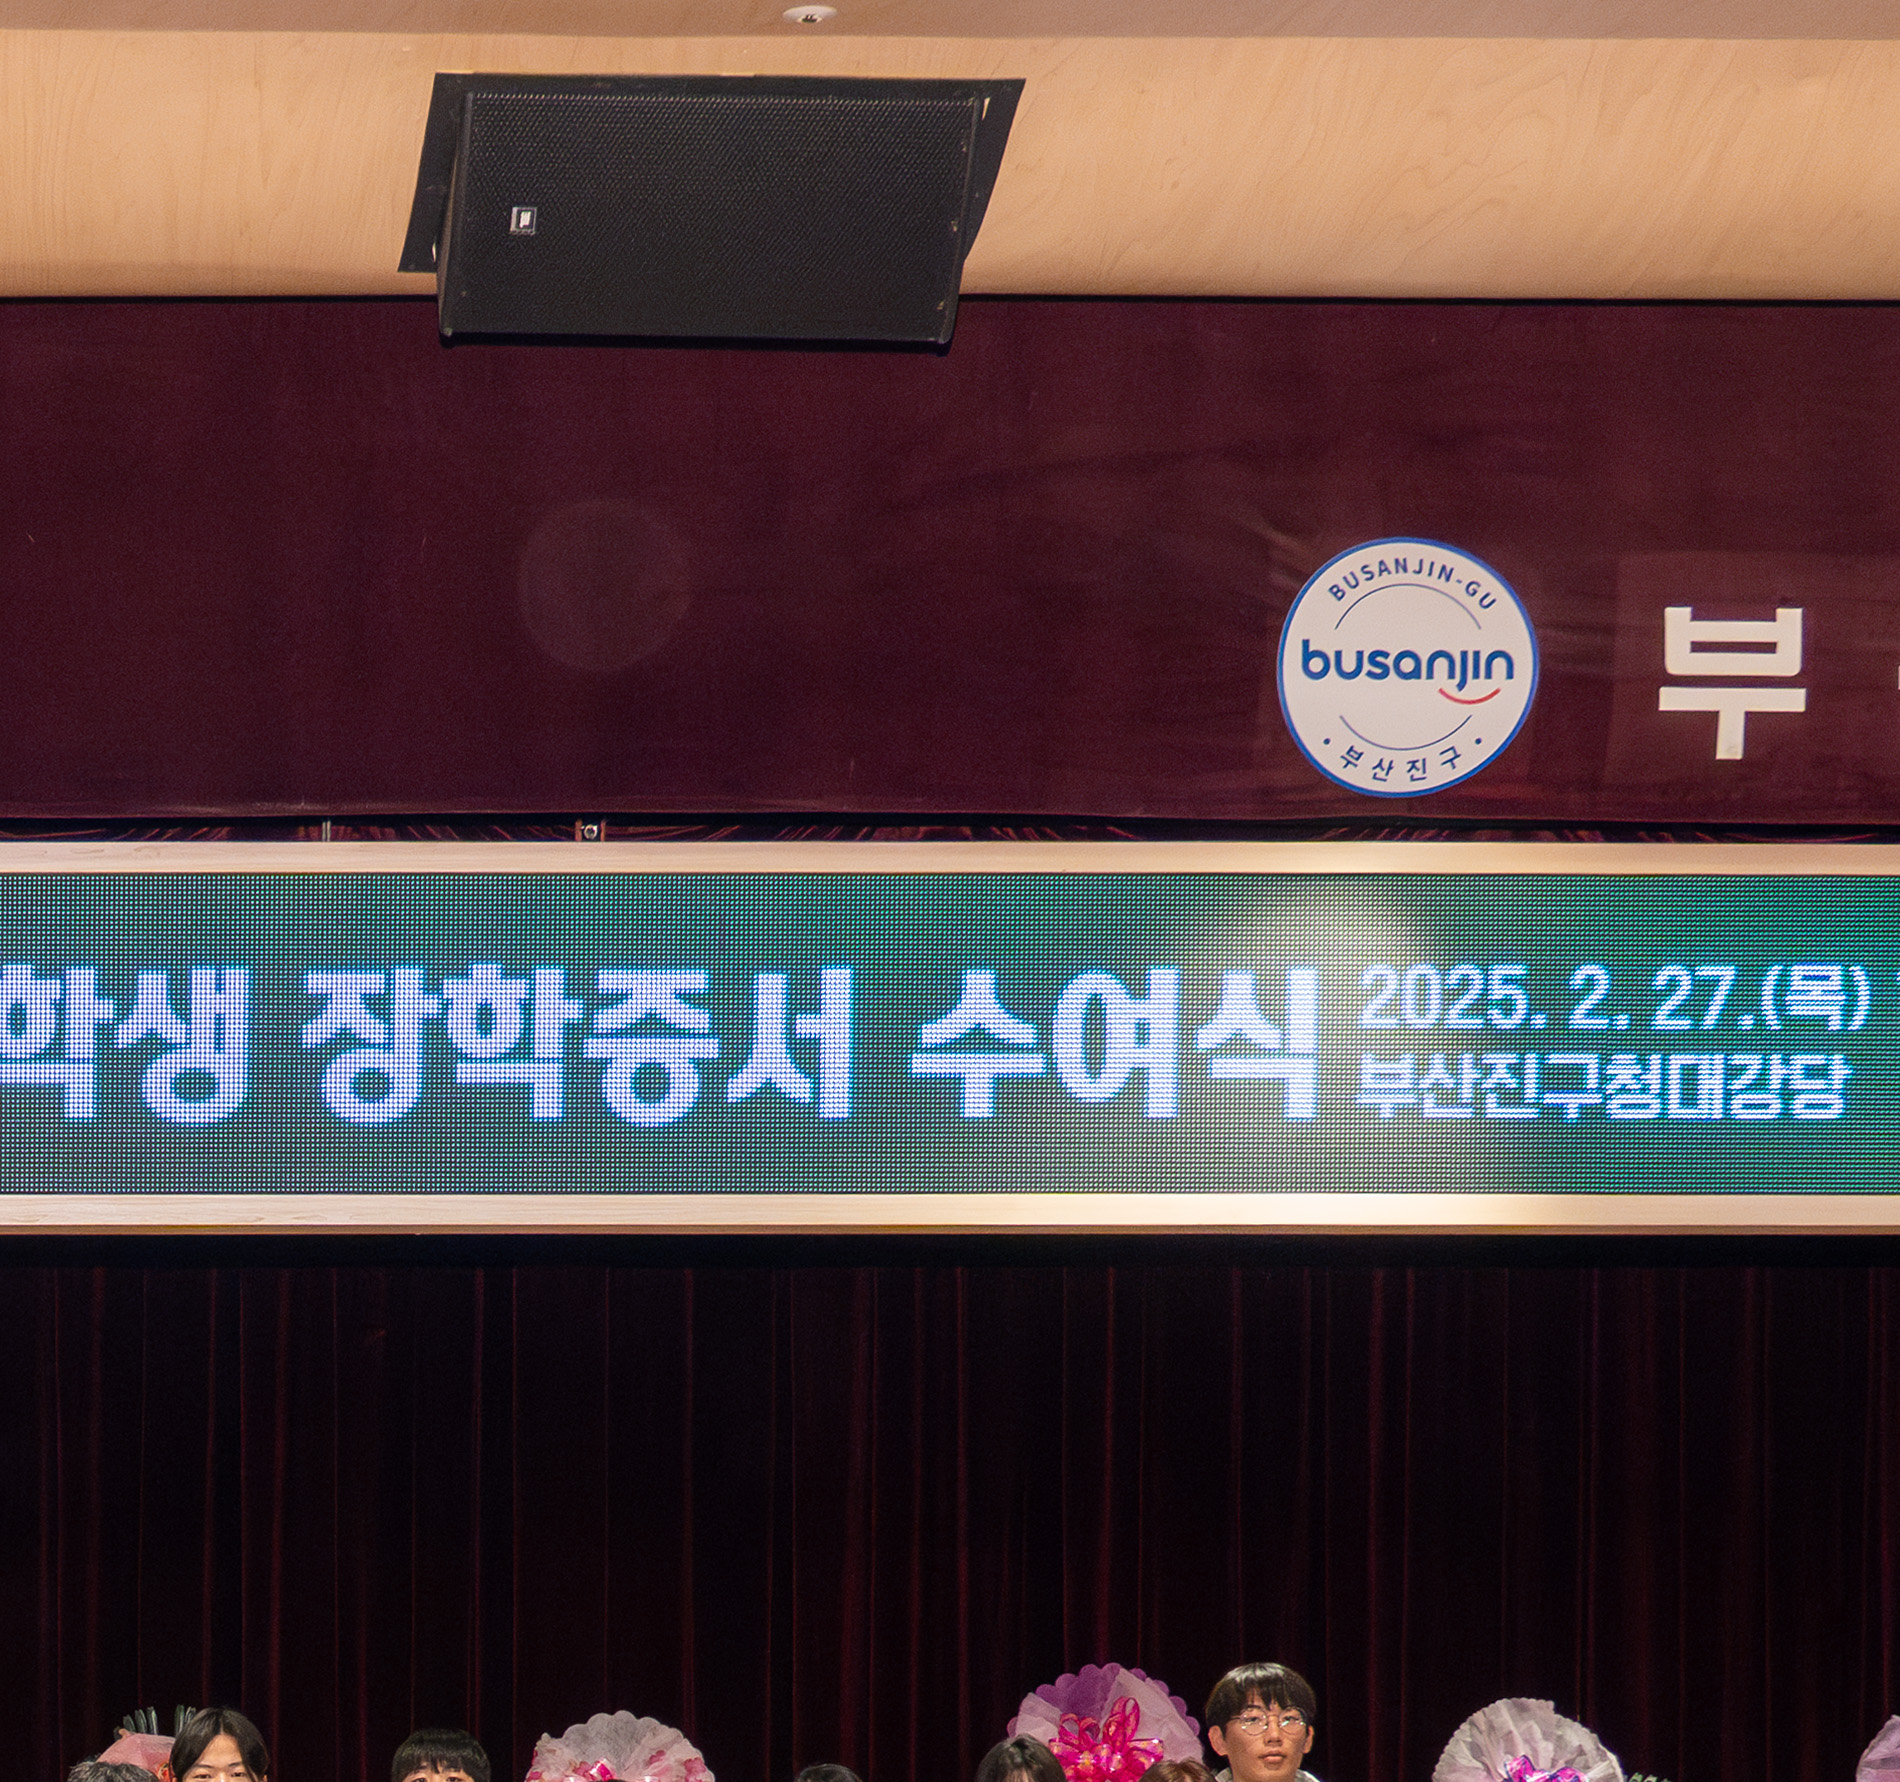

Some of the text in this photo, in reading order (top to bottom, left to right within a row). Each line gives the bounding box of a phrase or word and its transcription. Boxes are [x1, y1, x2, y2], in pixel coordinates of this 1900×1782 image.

[1328, 557, 1497, 610] BUSANJIN-GU
[1301, 638, 1514, 692] busanjin
[1340, 745, 1462, 783] 부산진구
[1358, 963, 1548, 1030] 2025.
[1569, 963, 1630, 1030] 2.
[1649, 962, 1871, 1033] 27.(목)
[299, 962, 855, 1127] 장학증서
[909, 963, 1319, 1120] 수여식
[1356, 1051, 1854, 1122] 부산진구청대강당
